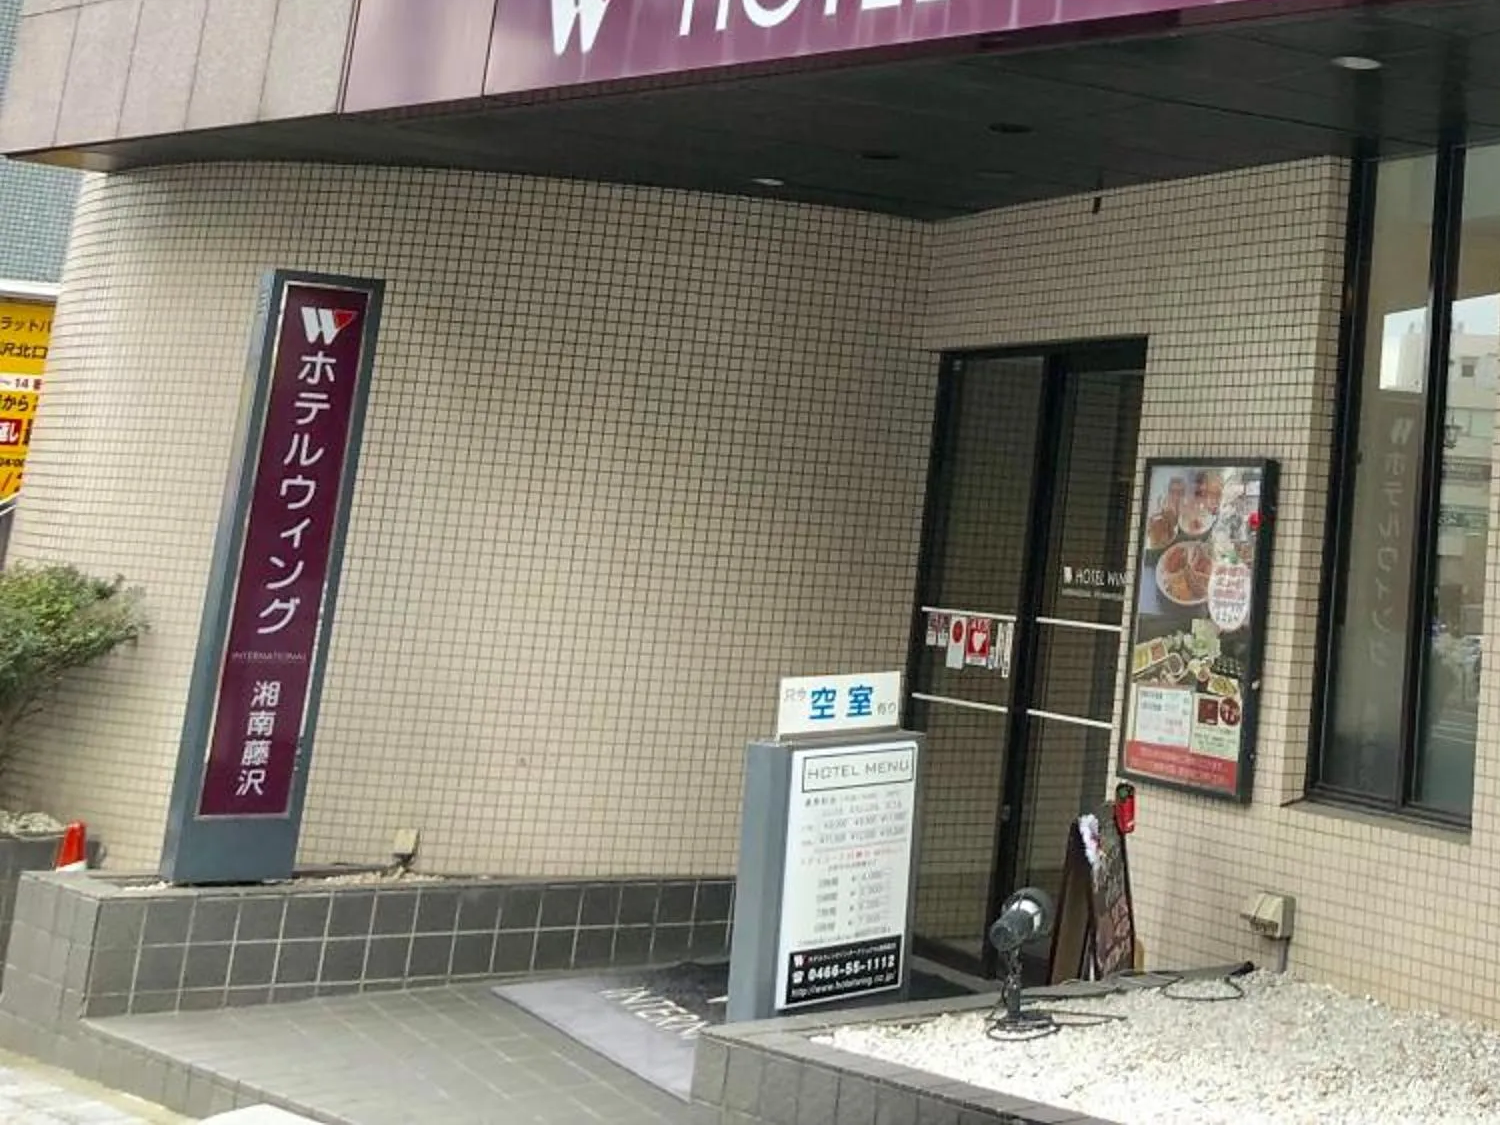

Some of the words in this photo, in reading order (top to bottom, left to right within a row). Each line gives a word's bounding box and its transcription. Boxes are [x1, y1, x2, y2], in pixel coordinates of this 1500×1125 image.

[258, 351, 337, 634] ホテルウィング
[1075, 568, 1105, 586] HOTEL
[809, 685, 873, 719] 空室
[236, 680, 281, 796] 湘南藤沢
[807, 764, 860, 780] HOTEL
[865, 758, 910, 776] MENU
[808, 955, 895, 982] 0466-55-1112
